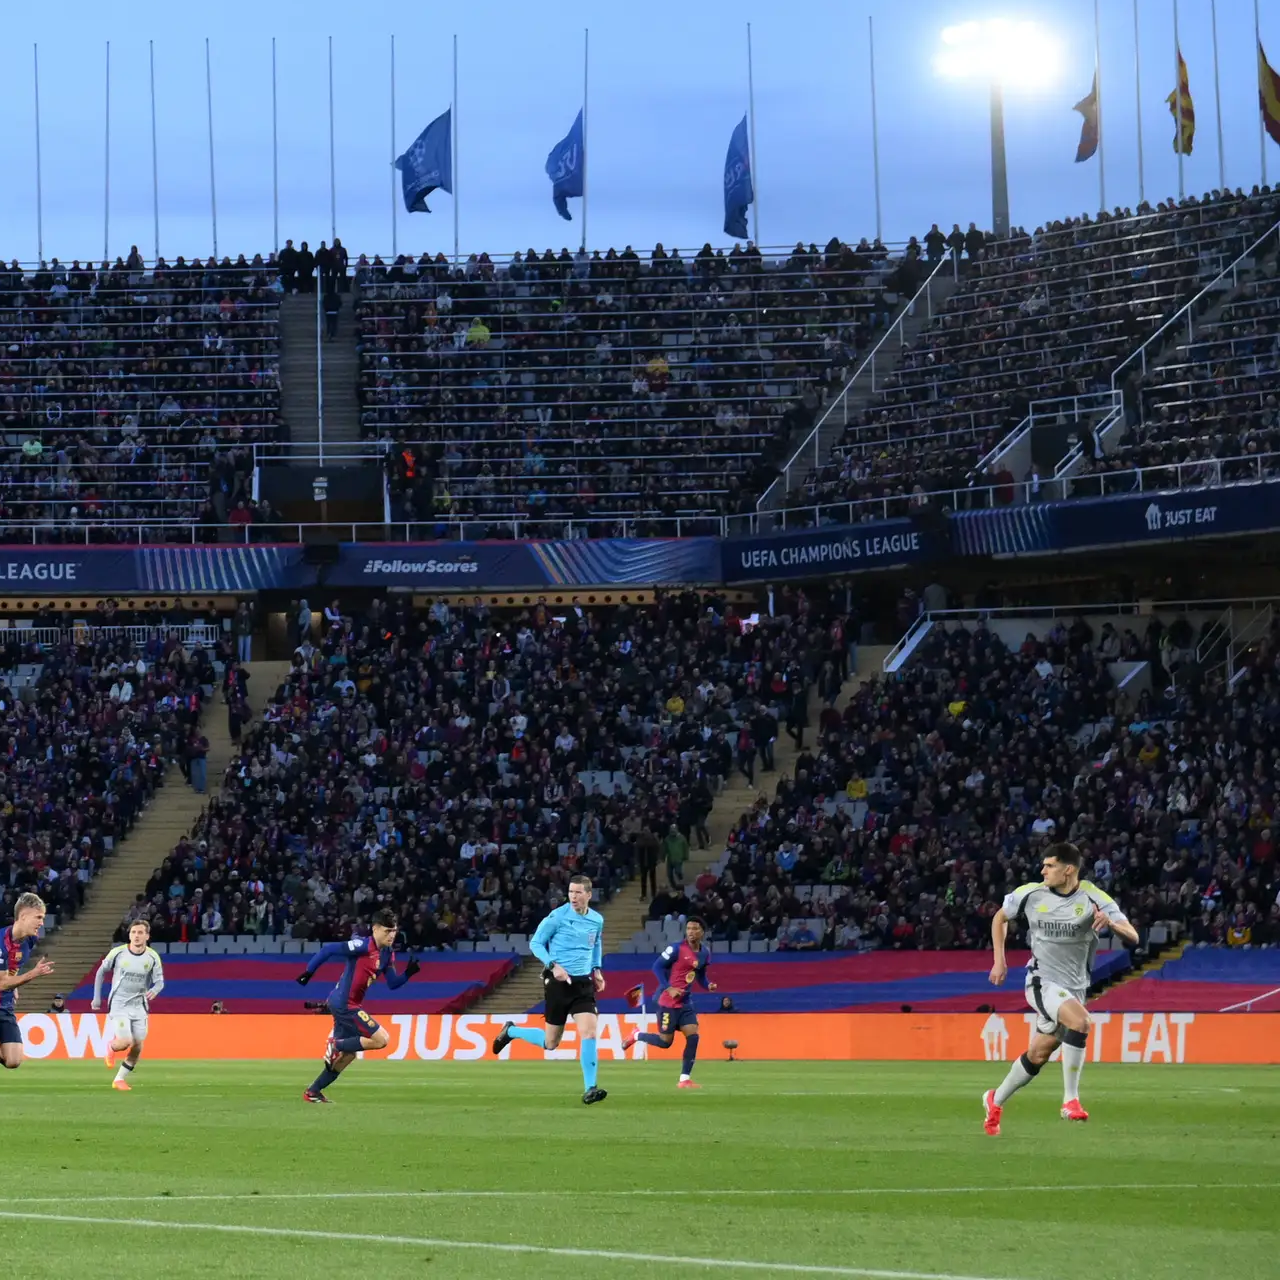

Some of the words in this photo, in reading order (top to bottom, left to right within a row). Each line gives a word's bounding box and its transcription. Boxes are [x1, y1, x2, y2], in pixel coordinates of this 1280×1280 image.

[1165, 508, 1193, 527] JUST
[1195, 506, 1217, 523] EAT
[741, 549, 778, 568] UEFA
[780, 539, 861, 565] CHAMPIONS
[865, 532, 920, 556] LEAGUE
[1037, 919, 1081, 930] Emirates
[357, 1010, 370, 1022] 8
[662, 1012, 670, 1024] 3
[1121, 1013, 1196, 1063] EAT
